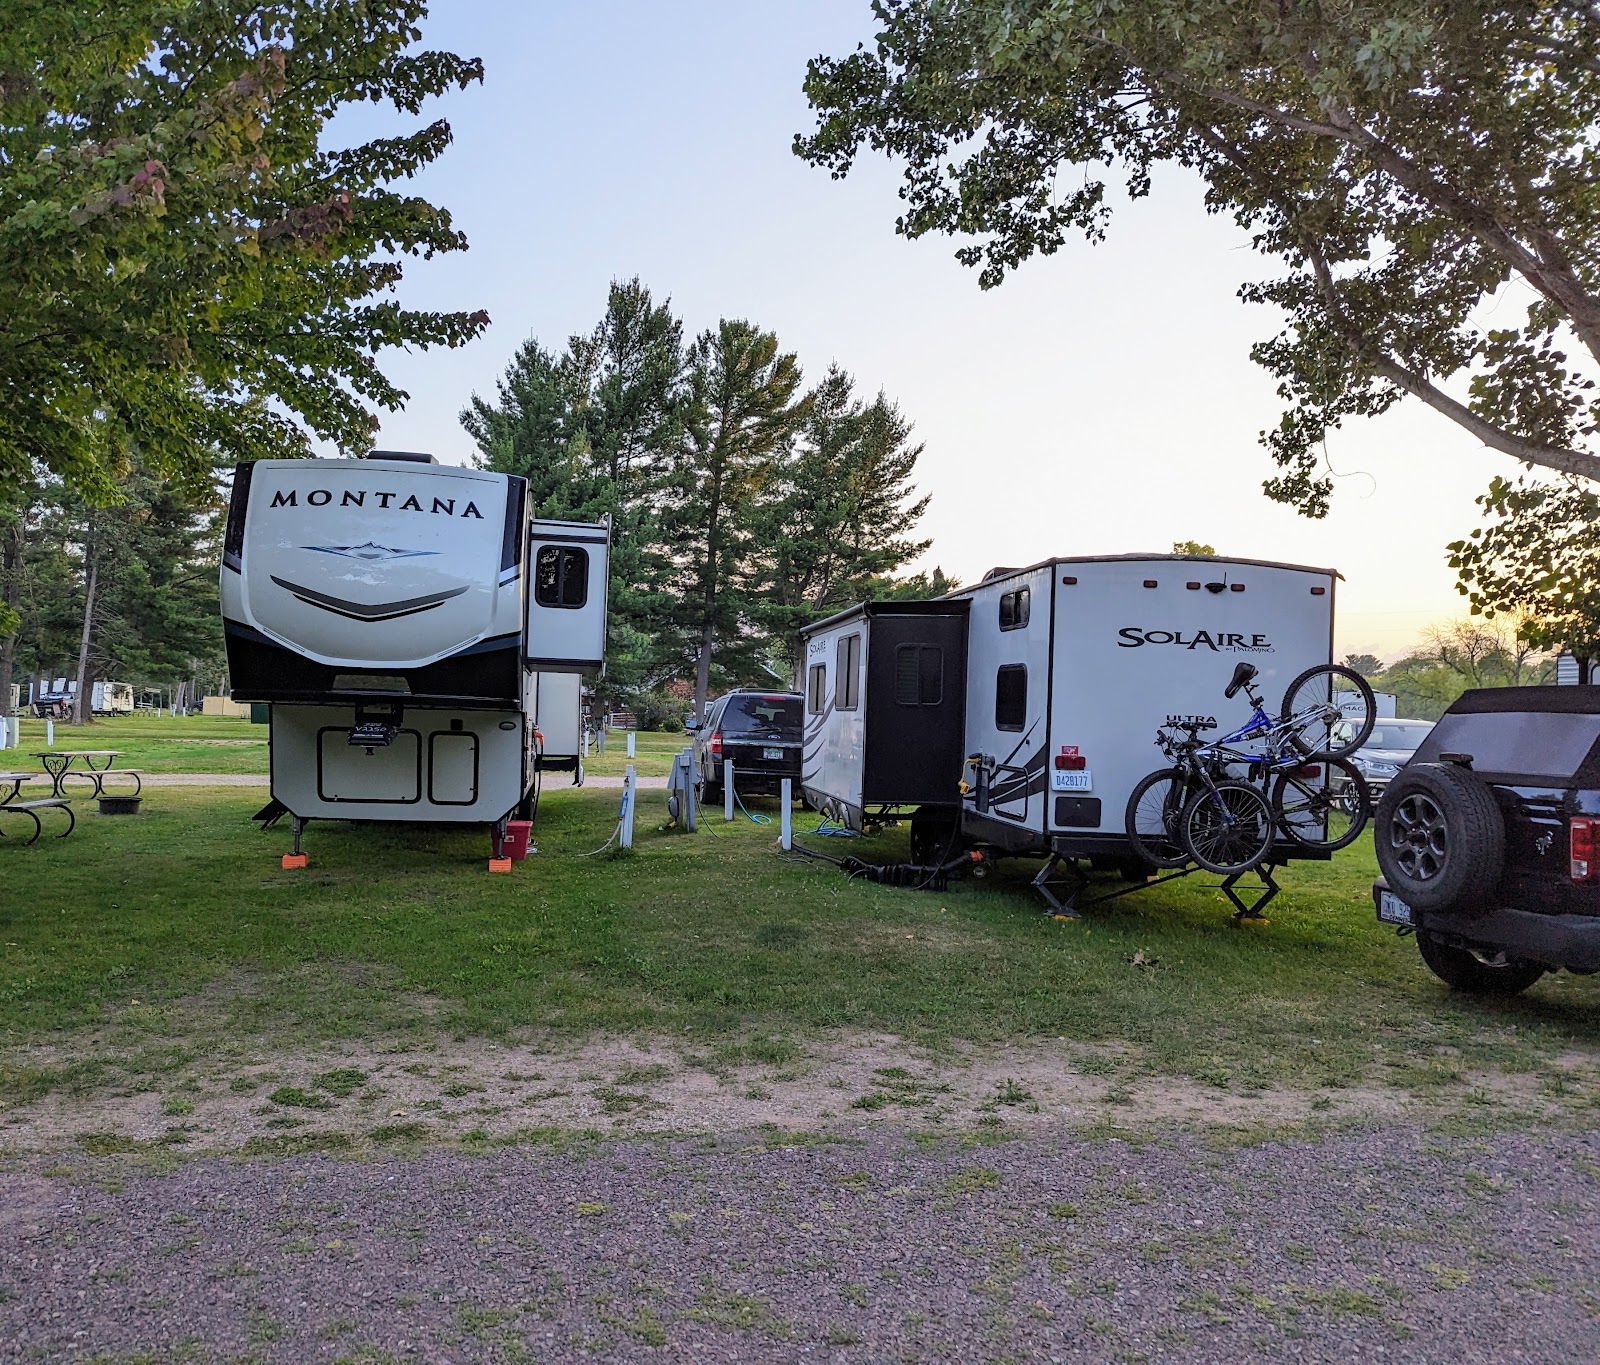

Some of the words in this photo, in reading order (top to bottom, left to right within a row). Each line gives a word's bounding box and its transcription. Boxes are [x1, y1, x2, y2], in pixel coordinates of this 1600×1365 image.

[269, 489, 484, 519] MONTANA
[1117, 627, 1271, 652] SOLAIRE
[1233, 646, 1275, 654] PALOMINO
[1166, 714, 1217, 722] ULTRA
[1056, 775, 1088, 787] D428177
